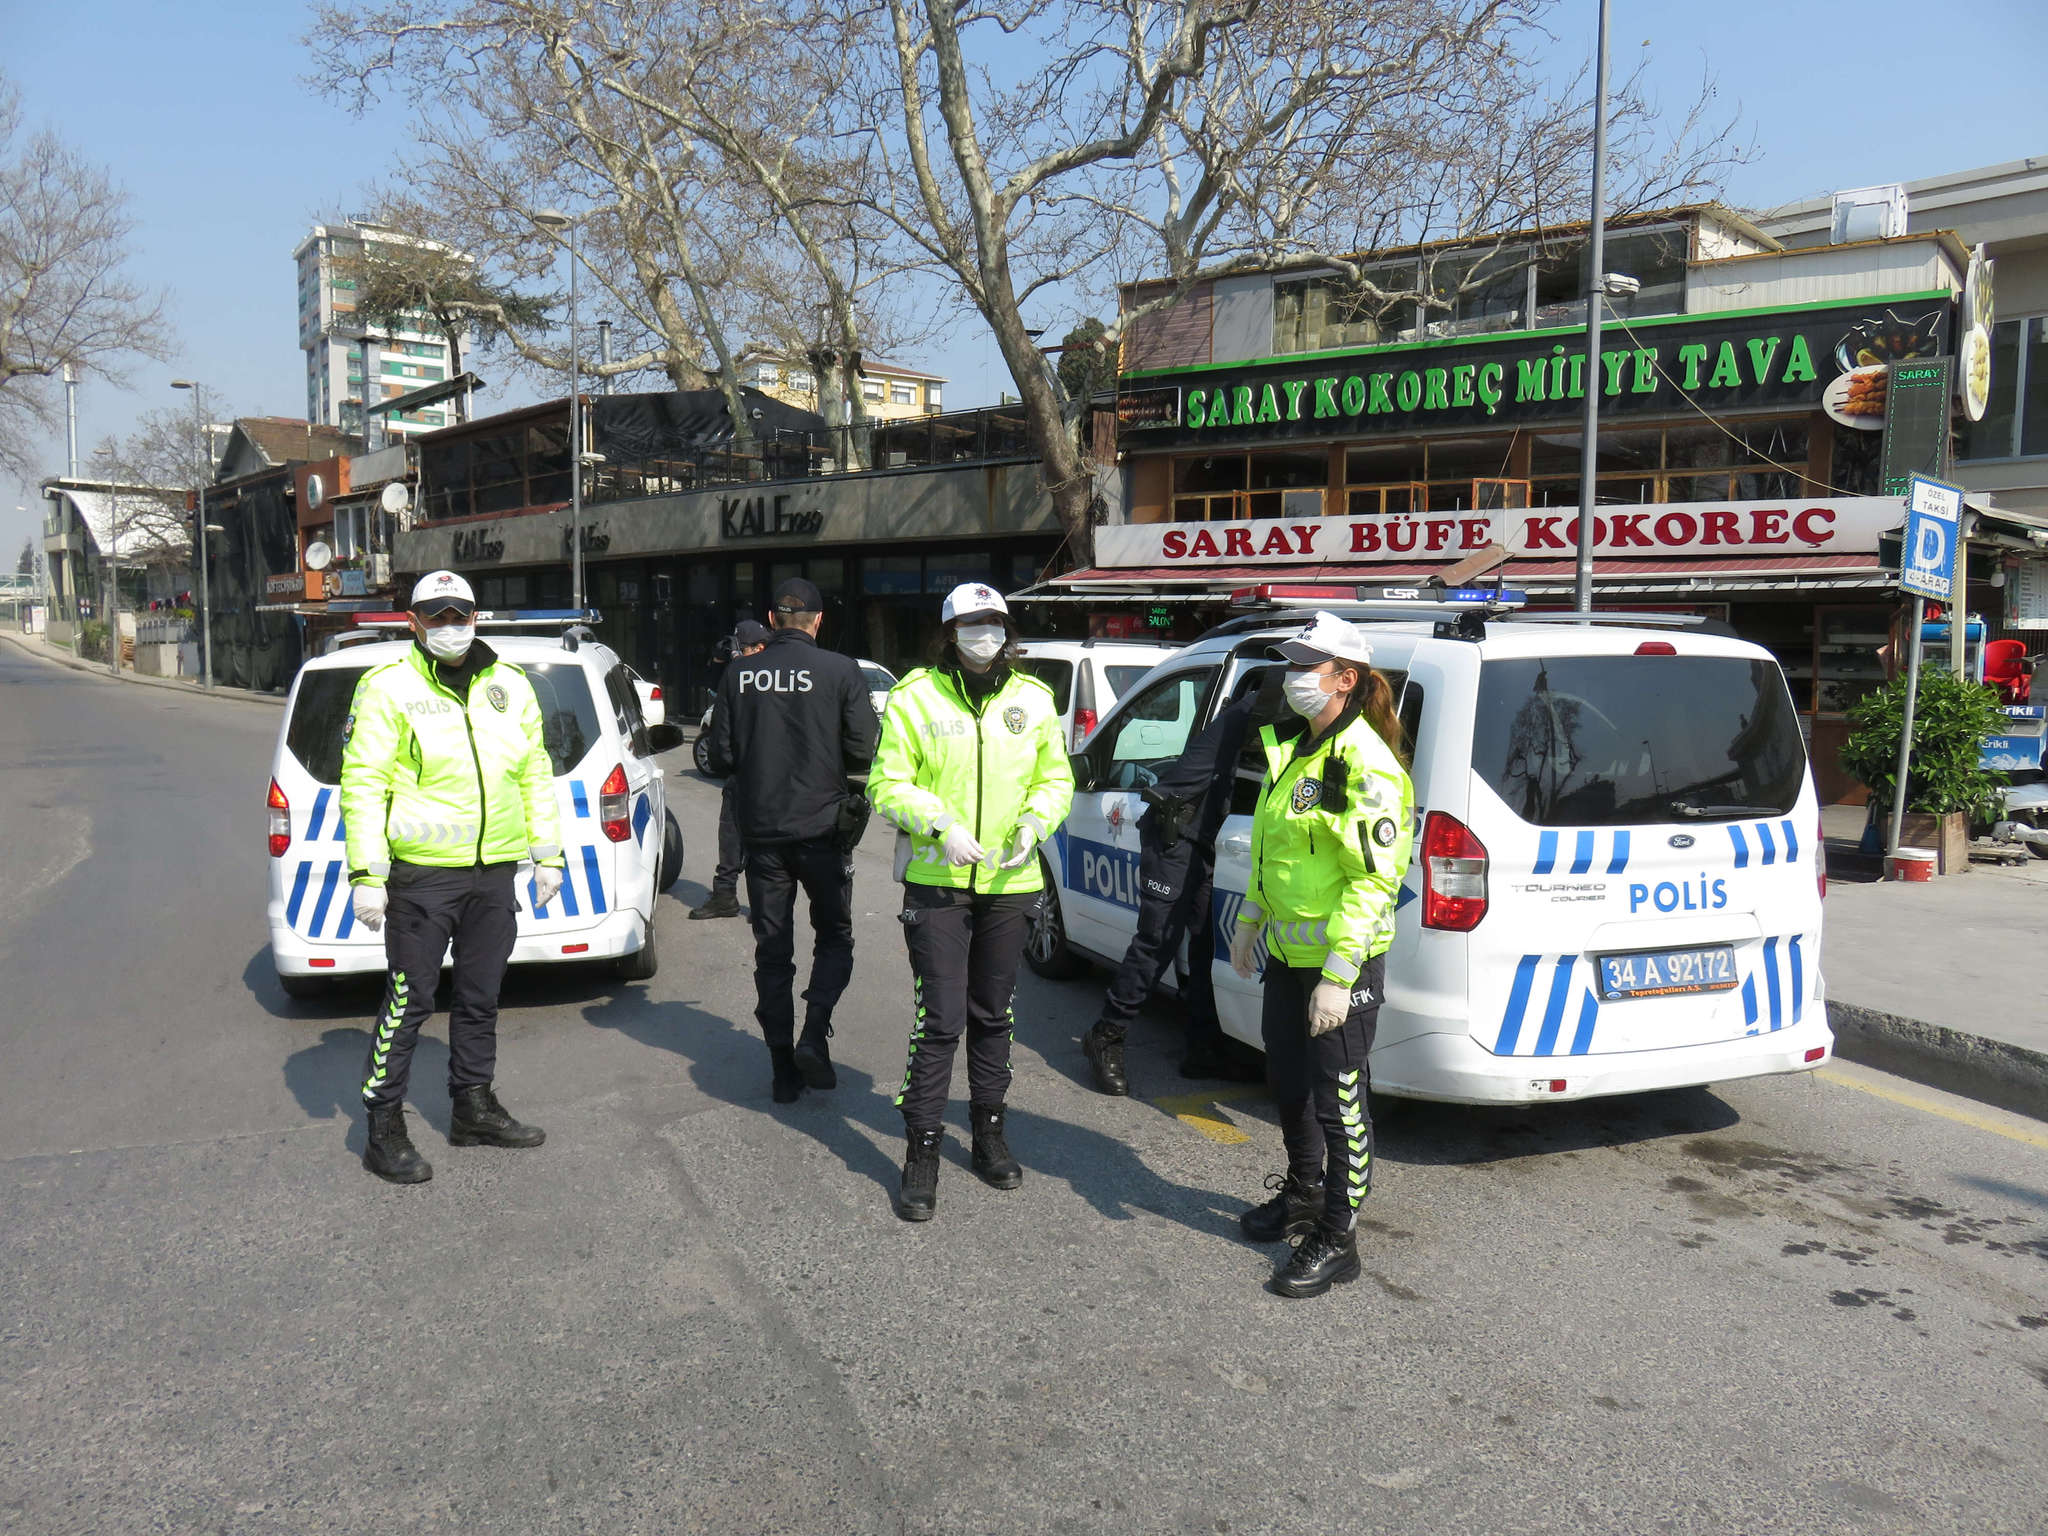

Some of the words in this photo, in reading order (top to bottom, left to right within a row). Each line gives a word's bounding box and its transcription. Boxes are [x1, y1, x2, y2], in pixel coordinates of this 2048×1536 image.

[1187, 380, 1307, 428] SARAY
[1313, 363, 1503, 416] KOKOREÇ
[1678, 334, 1817, 390] TAVA
[1898, 368, 1942, 381] SARAY
[1927, 488, 1946, 501] ÖZEL
[721, 495, 791, 538] KALE
[1922, 501, 1949, 516] TAKSİ
[1162, 525, 1322, 559] SARAY
[1348, 515, 1493, 553] BÜFE
[1523, 508, 1836, 549] KOKOREÇ
[1915, 517, 1946, 570] D
[1382, 588, 1419, 599] CSR
[1511, 882, 1606, 893] TOURNEO
[1550, 894, 1606, 903] COURIER
[1629, 871, 1728, 913] POLİS
[1608, 958, 1637, 989] 34
[1644, 957, 1662, 985] A
[1667, 951, 1730, 982] 92172
